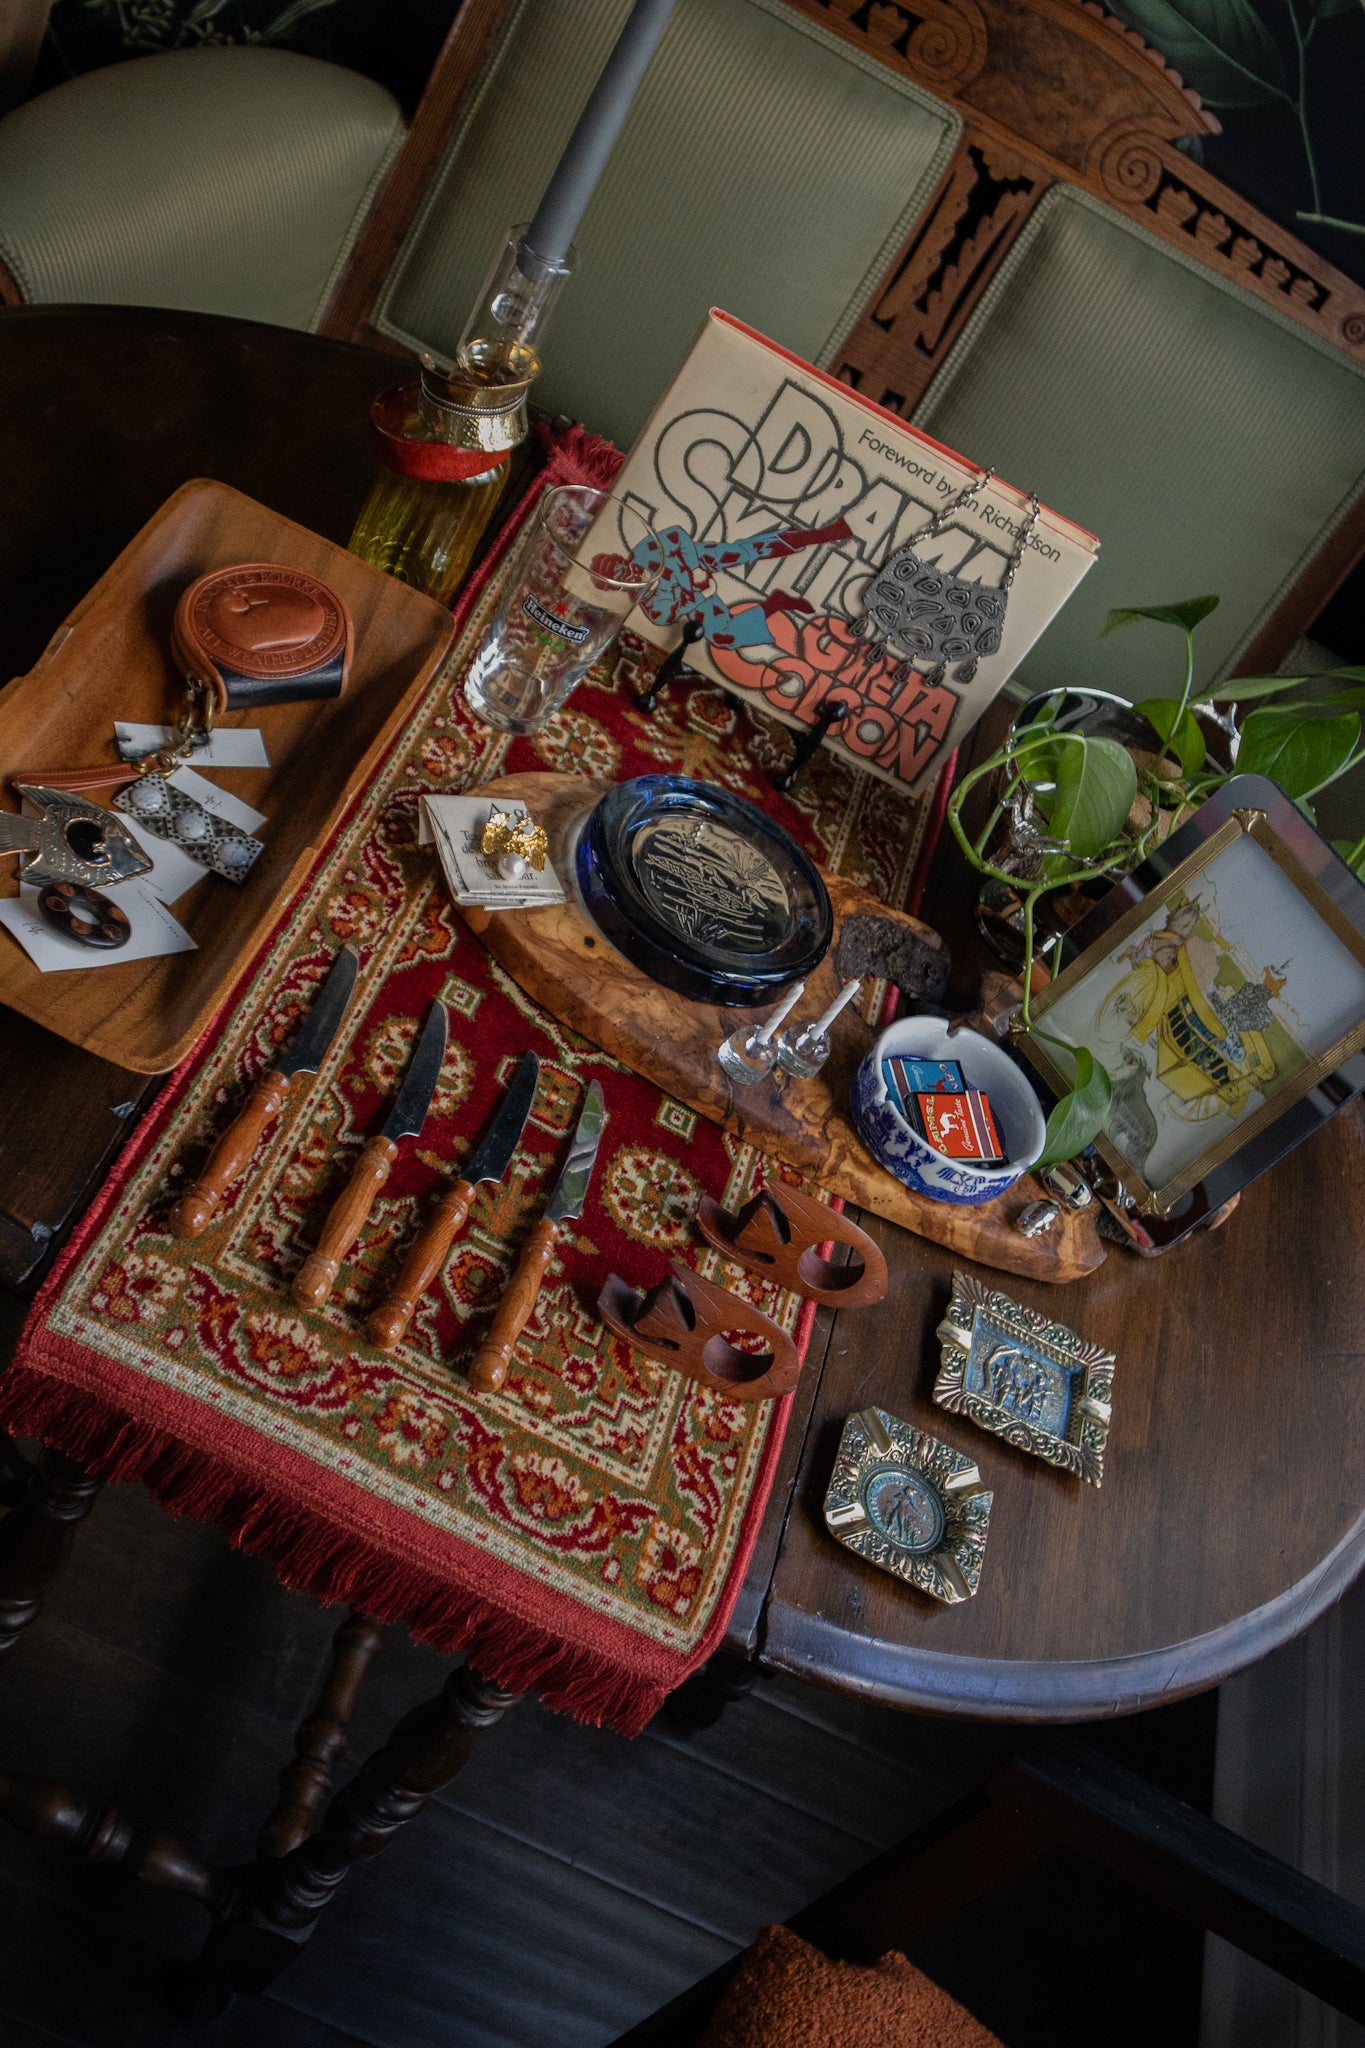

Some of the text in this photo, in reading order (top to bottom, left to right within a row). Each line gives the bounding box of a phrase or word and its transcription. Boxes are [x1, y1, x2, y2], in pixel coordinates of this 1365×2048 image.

[857, 428, 937, 485] Foreword
[936, 478, 957, 499] by
[979, 503, 1062, 563] Richadson
[260, 571, 321, 598] BOURKE
[229, 647, 300, 665] WEATHER
[303, 607, 338, 658] LEATHER
[526, 599, 584, 640] Heineken
[926, 1096, 948, 1154] CAMEL
[961, 1119, 974, 1152] Genuine
